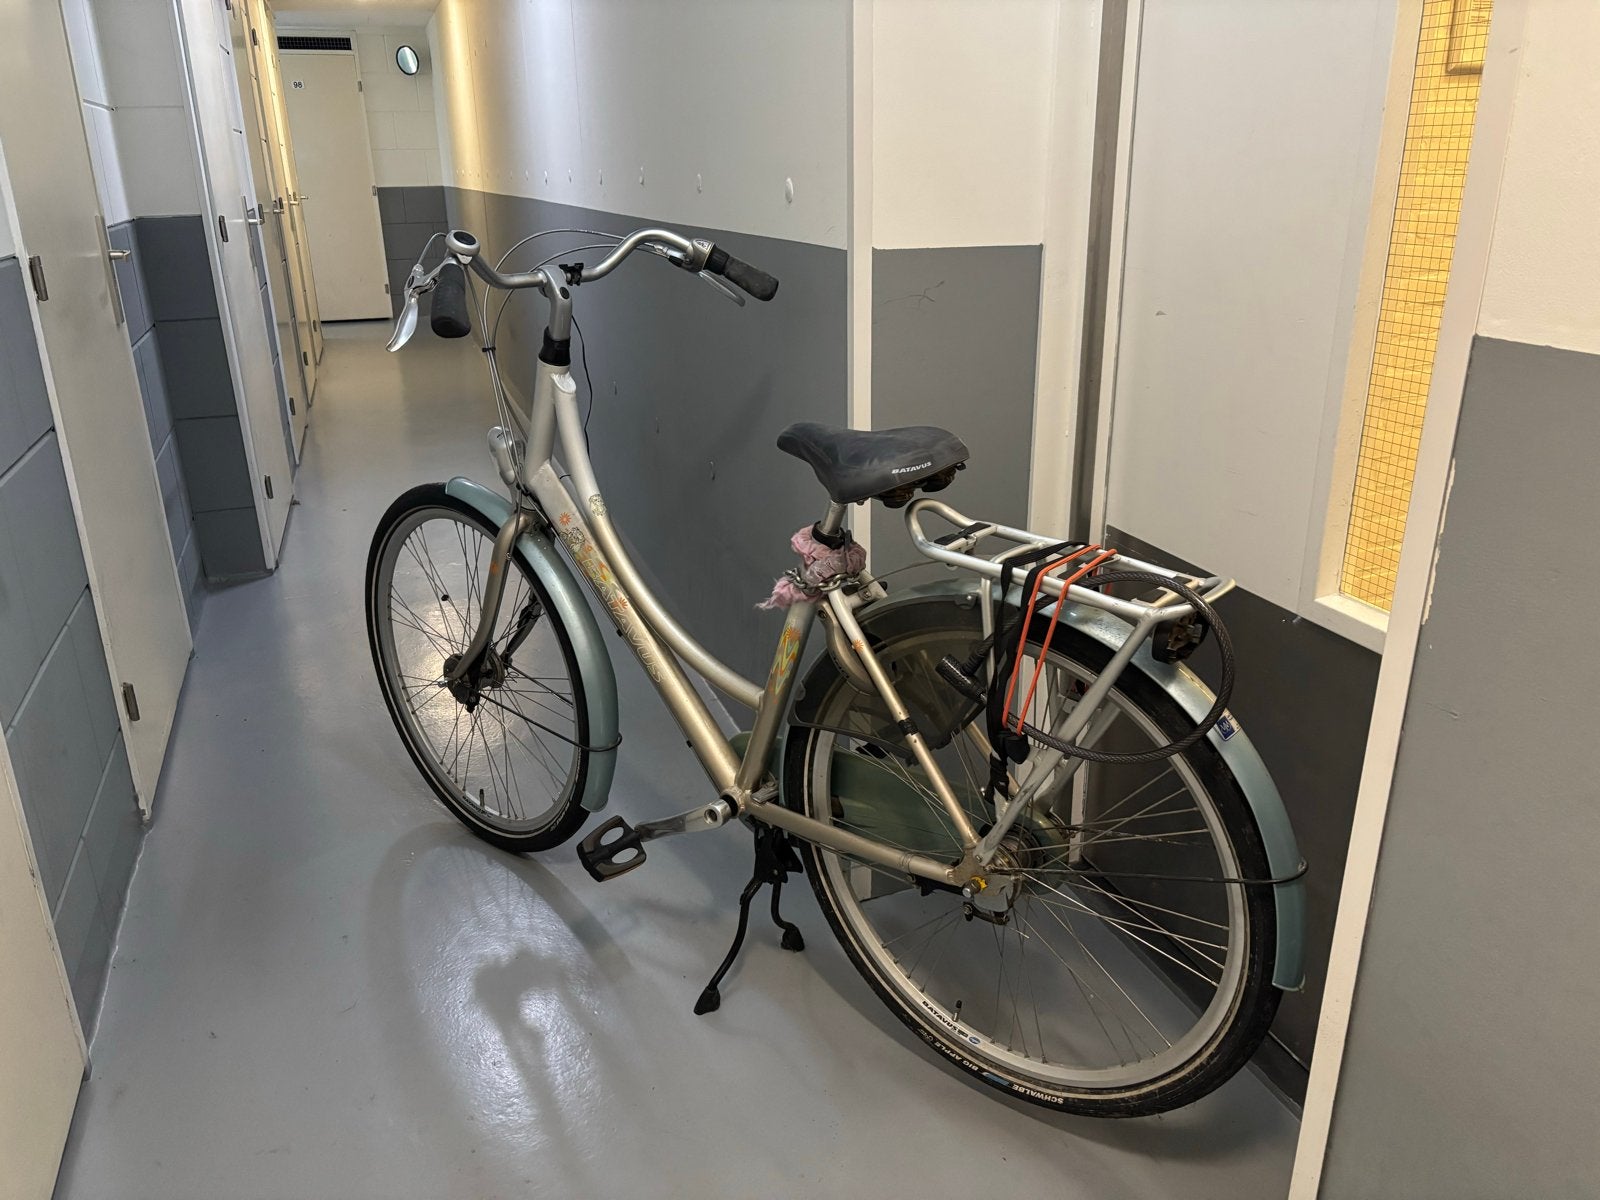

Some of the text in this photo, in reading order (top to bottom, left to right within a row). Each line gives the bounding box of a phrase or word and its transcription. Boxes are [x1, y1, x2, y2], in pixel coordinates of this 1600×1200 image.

[892, 461, 932, 474] BATAVUS
[583, 559, 662, 682] BATAVUS
[921, 1000, 957, 1033] BATAVUS
[934, 1042, 1064, 1104] SCHWALBE BIG APPLE
